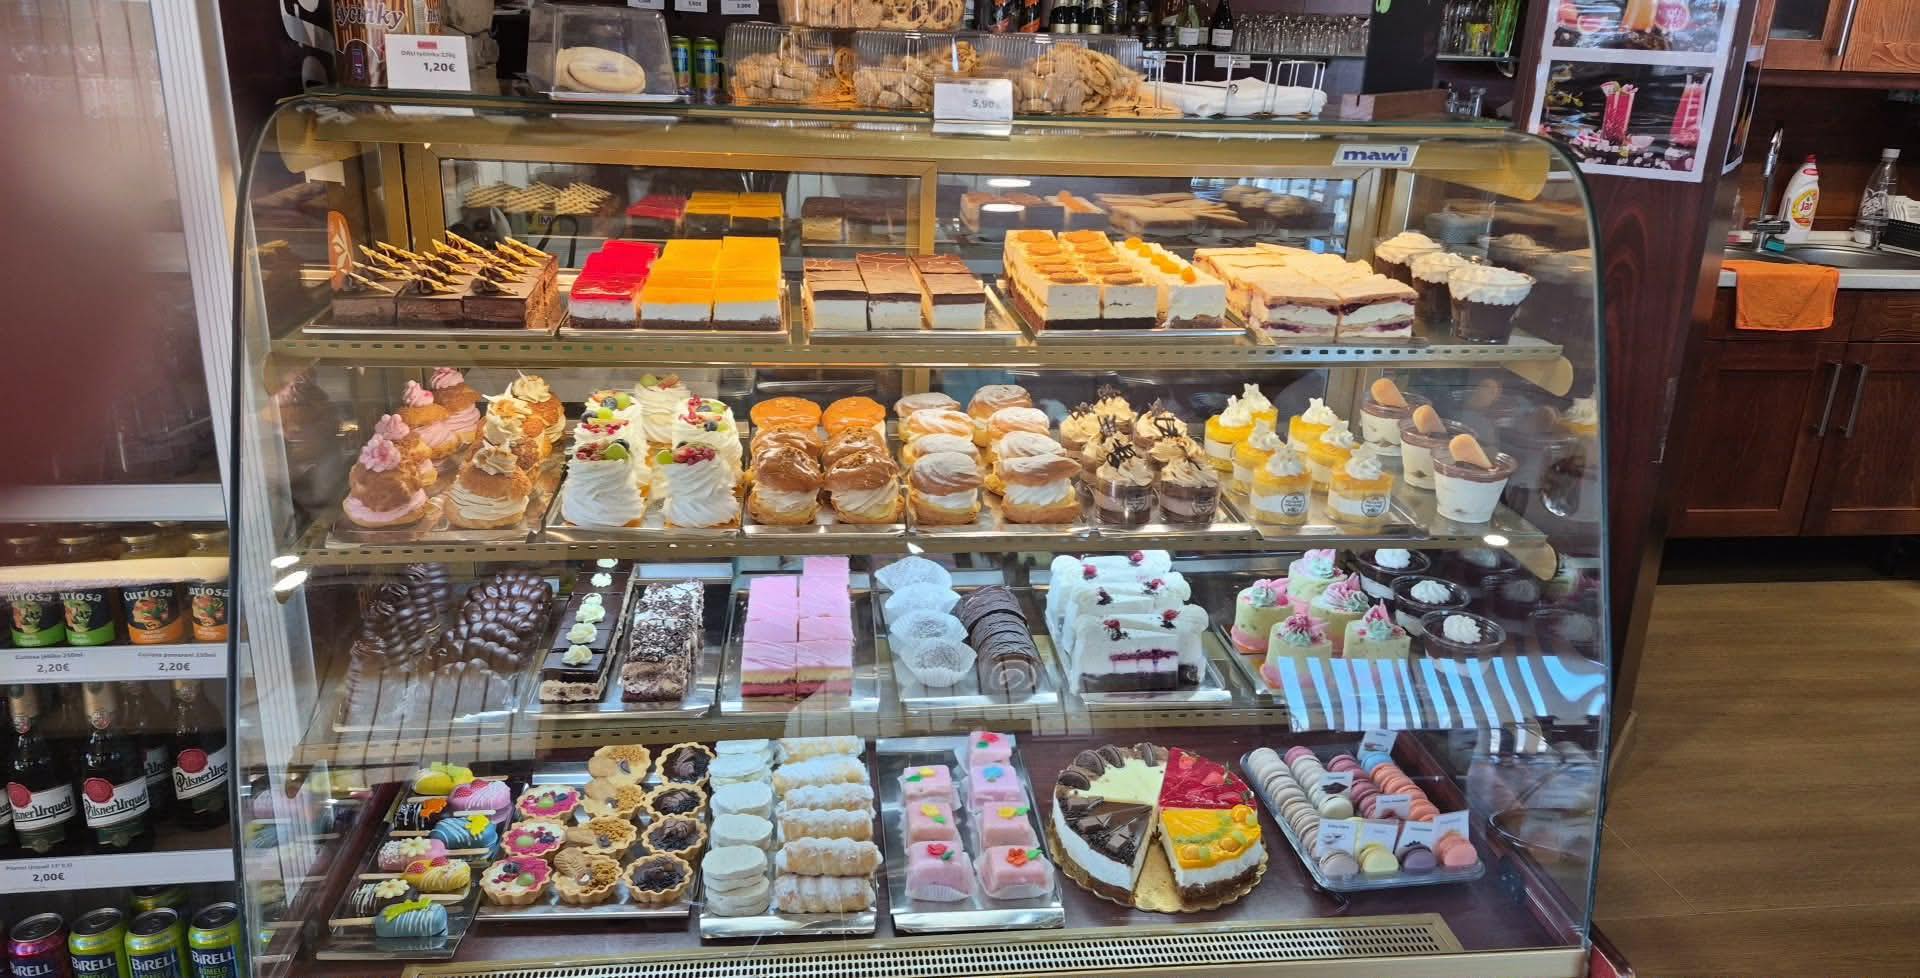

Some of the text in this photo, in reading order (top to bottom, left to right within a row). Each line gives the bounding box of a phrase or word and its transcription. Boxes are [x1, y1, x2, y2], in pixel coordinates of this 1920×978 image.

[423, 62, 456, 73] 1,20€
[1343, 146, 1408, 161] mawi
[1800, 201, 1813, 211] Jar
[123, 587, 173, 601] Curiosa
[37, 663, 70, 673] 2,20€
[158, 662, 191, 672] 2,20€
[176, 770, 211, 793] Pilsner
[32, 795, 72, 818] Urquell
[84, 799, 117, 819] Pilsner
[33, 872, 65, 882] 2,00€
